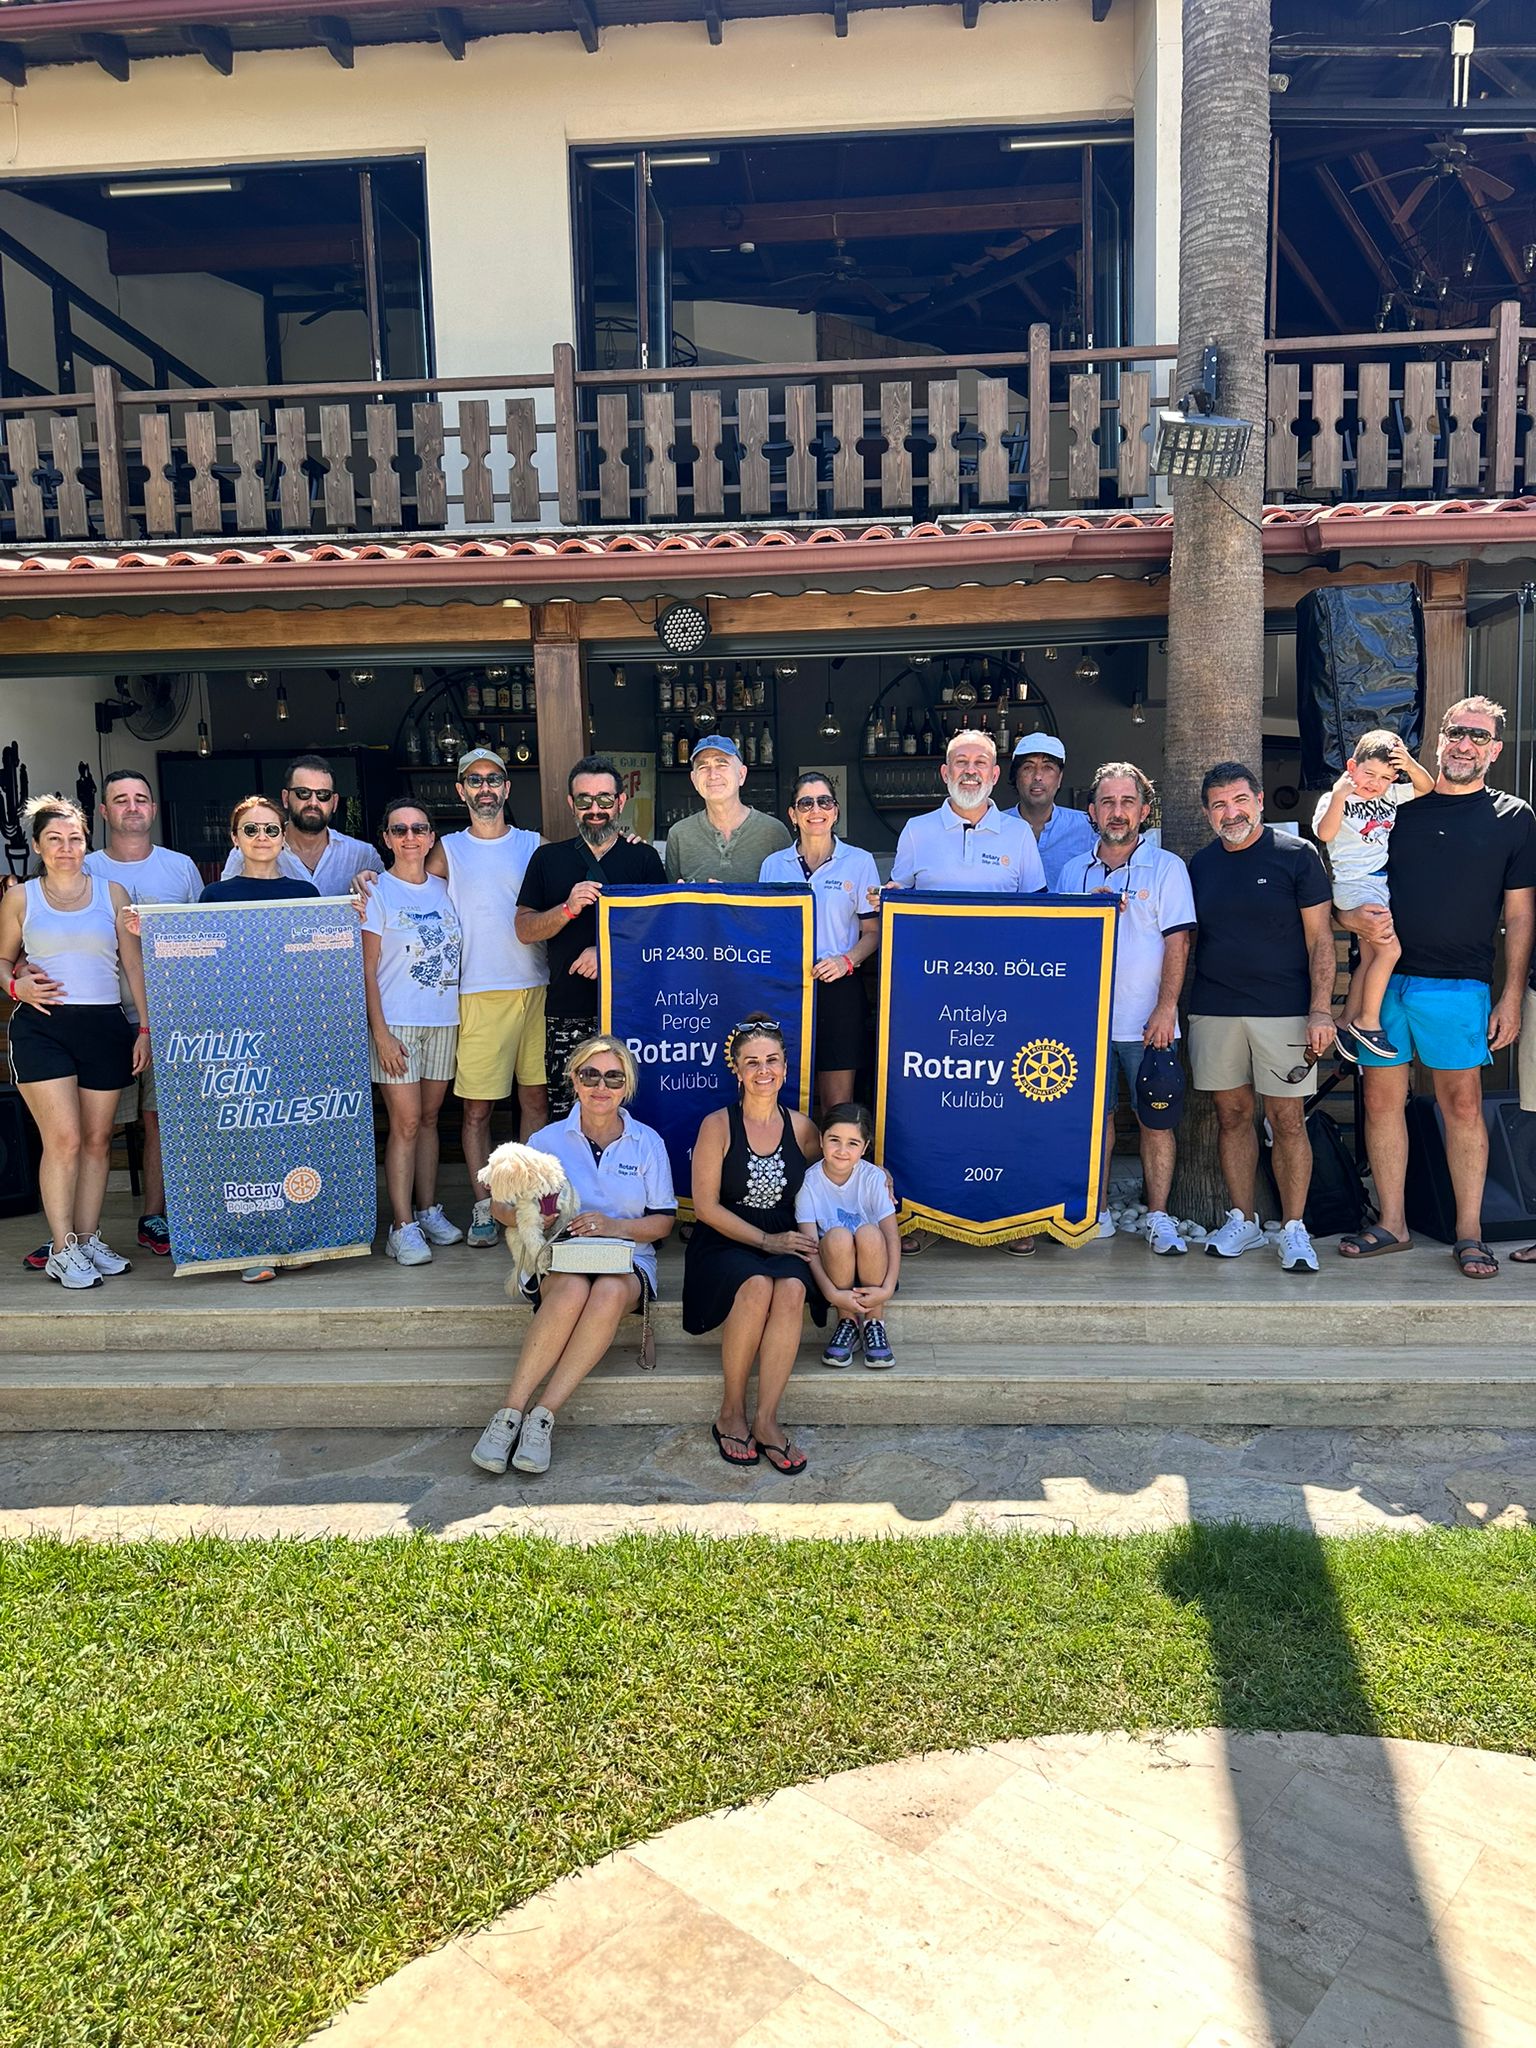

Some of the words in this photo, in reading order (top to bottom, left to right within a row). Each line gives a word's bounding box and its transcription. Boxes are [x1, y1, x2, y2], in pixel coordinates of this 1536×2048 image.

[155, 933, 197, 941] Francesco
[198, 931, 226, 939] Arezzo
[301, 927, 318, 935] Can
[642, 947, 662, 962] UR
[666, 946, 708, 961] 2430.
[713, 945, 772, 964] BÖLGE
[924, 960, 949, 974] UR
[954, 961, 998, 975] 2430.
[1004, 958, 1067, 977] BÖLGE
[654, 988, 719, 1010] Antalya
[662, 1013, 711, 1034] Perge
[938, 1004, 1007, 1027] Antalya
[168, 1029, 264, 1062] İYİLİK
[950, 1029, 995, 1047] Falez
[626, 1037, 718, 1067] Rotary
[1032, 1045, 1059, 1053] ROTARY
[903, 1051, 1005, 1085] Rotary
[201, 1063, 270, 1098] İÇİN
[660, 1071, 718, 1092] Kulübü
[1021, 1078, 1068, 1096] INTERNATIONAL
[217, 1088, 362, 1129] BİRLEŞİN
[941, 1090, 1004, 1109] Kulübü
[964, 1167, 1004, 1182] 2007
[225, 1182, 281, 1198] Rotary
[227, 1201, 256, 1213] Bölge
[257, 1200, 284, 1211] 2430
